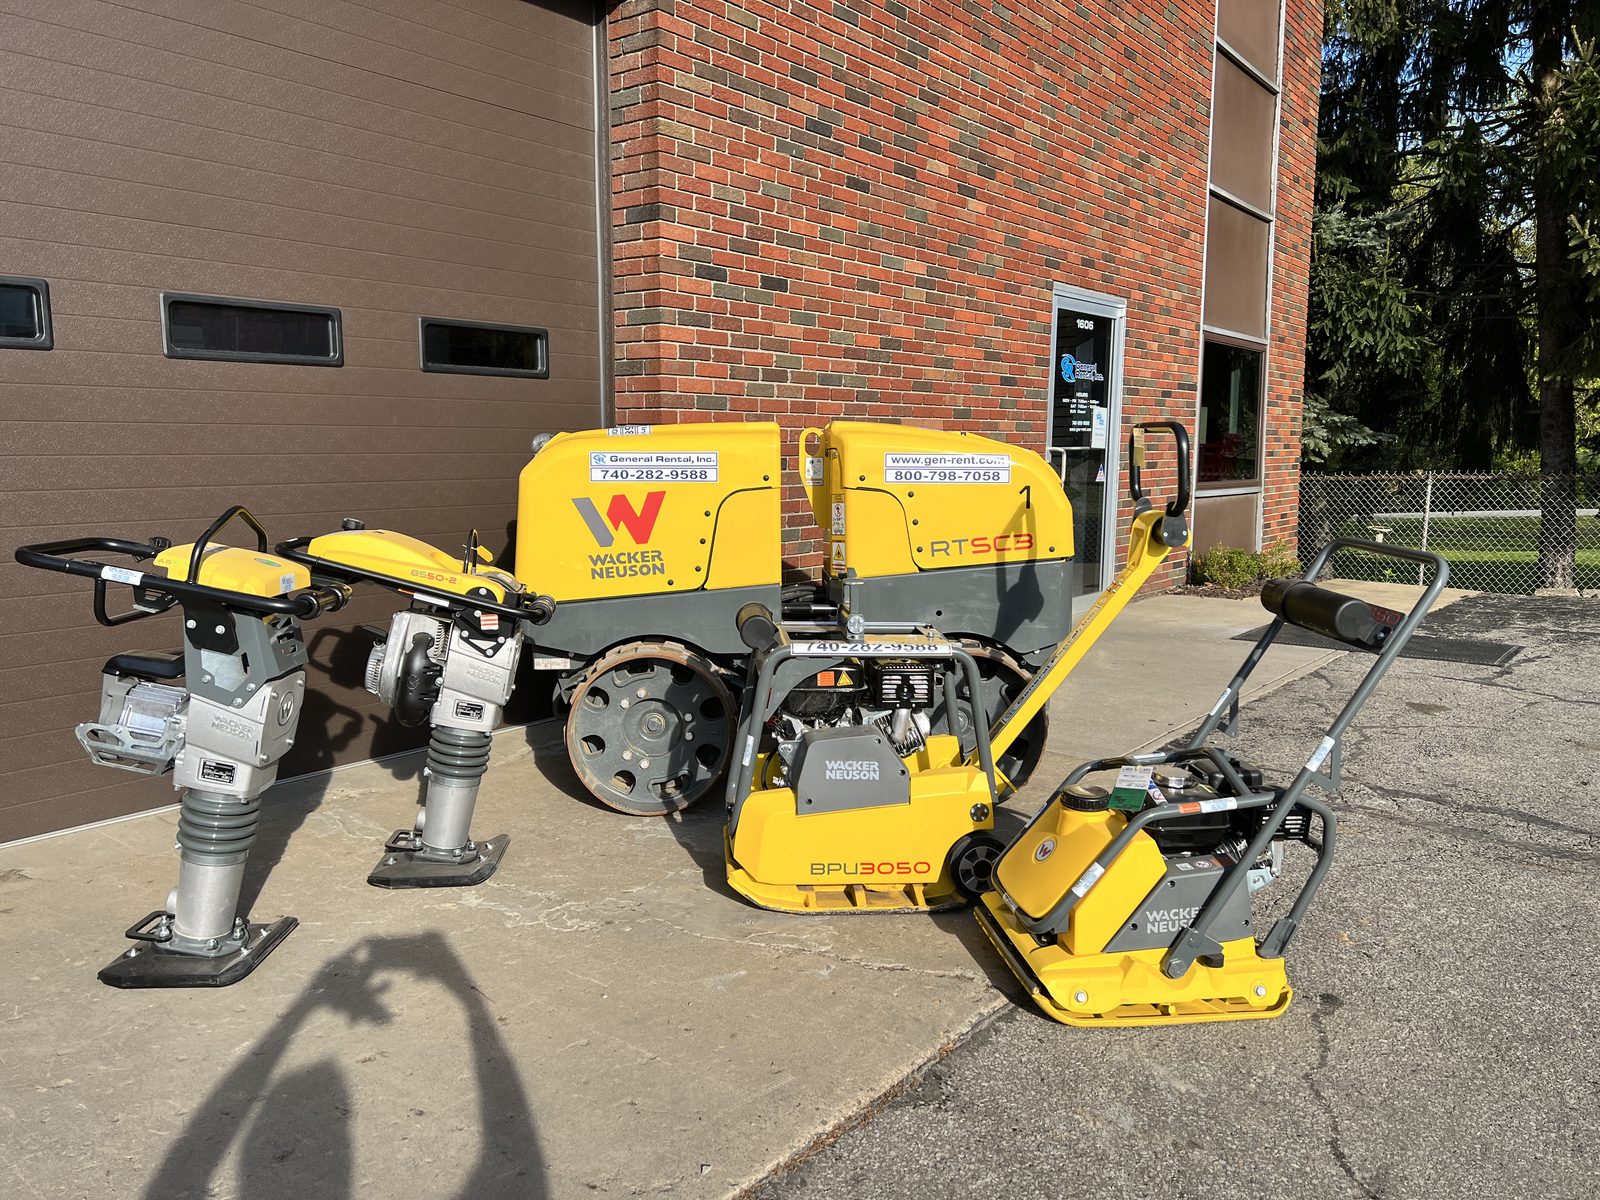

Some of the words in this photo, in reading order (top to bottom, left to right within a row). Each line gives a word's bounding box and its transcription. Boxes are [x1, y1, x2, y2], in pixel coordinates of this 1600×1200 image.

[1076, 319, 1094, 330] 1606
[1075, 361, 1097, 372] General
[609, 455, 653, 463] General
[655, 455, 694, 464] Rental,
[696, 455, 715, 463] Inc.
[891, 456, 1006, 467] www.gen-rent.com
[600, 470, 708, 480] 740-282-9588
[894, 470, 1001, 481] 800-798-7058
[930, 533, 1034, 557] RTSC3
[588, 550, 664, 566] WACKER
[411, 569, 457, 585] BS50-2
[591, 563, 665, 580] NEUSON
[825, 760, 879, 770] WACKER
[825, 771, 880, 780] NEUSON
[810, 861, 931, 875] BPU3050
[1145, 906, 1201, 922] WACKE
[1146, 918, 1194, 934] NEUS
